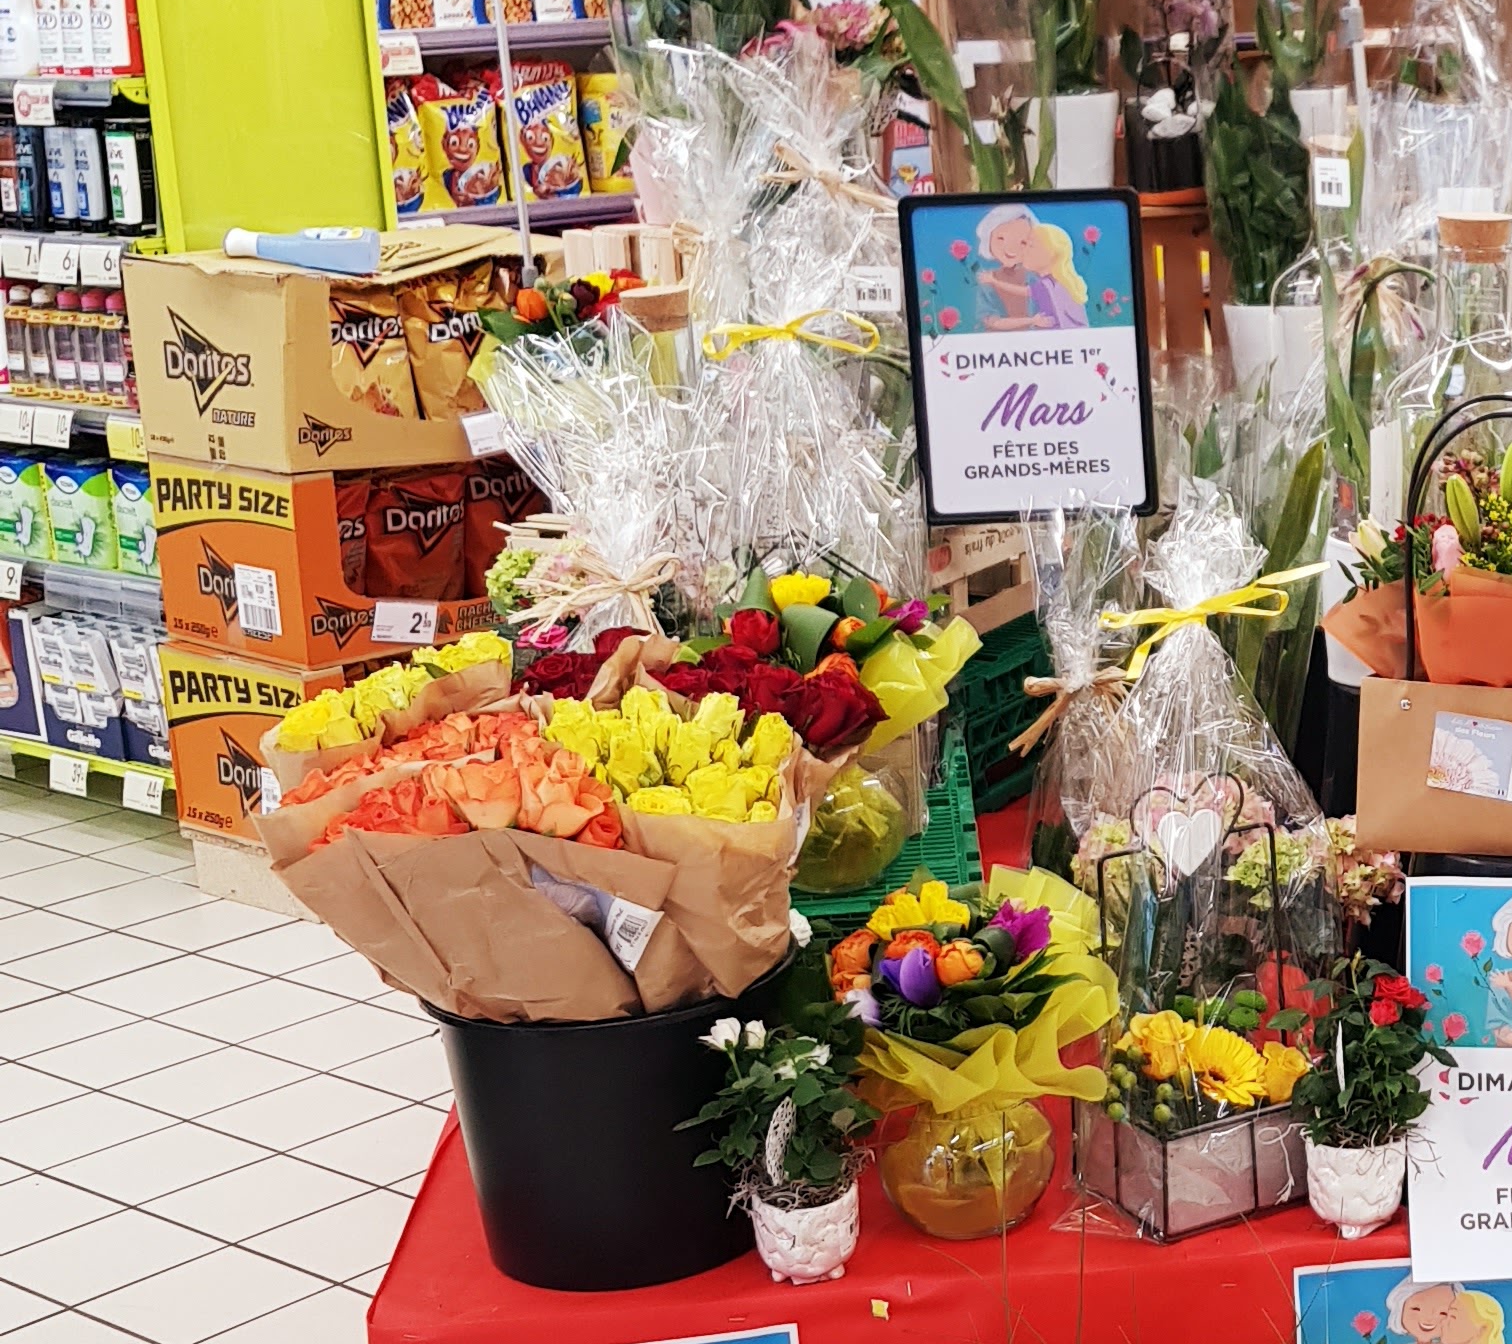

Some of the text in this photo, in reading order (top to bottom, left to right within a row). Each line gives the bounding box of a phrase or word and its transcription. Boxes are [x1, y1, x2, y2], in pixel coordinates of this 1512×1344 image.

[163, 340, 252, 388] Doritos
[955, 347, 1102, 371] DIMANCHE 1er
[212, 408, 256, 428] NATURE
[980, 382, 1094, 432] Mars
[299, 425, 353, 447] Doritos
[993, 440, 1080, 459] FÊTE DES
[964, 457, 1111, 480] GRANDS-MÈRES
[155, 477, 291, 519] PARTY SIZE
[198, 562, 237, 599] Dori
[169, 670, 252, 706] PARTY
[186, 806, 197, 818] 15
